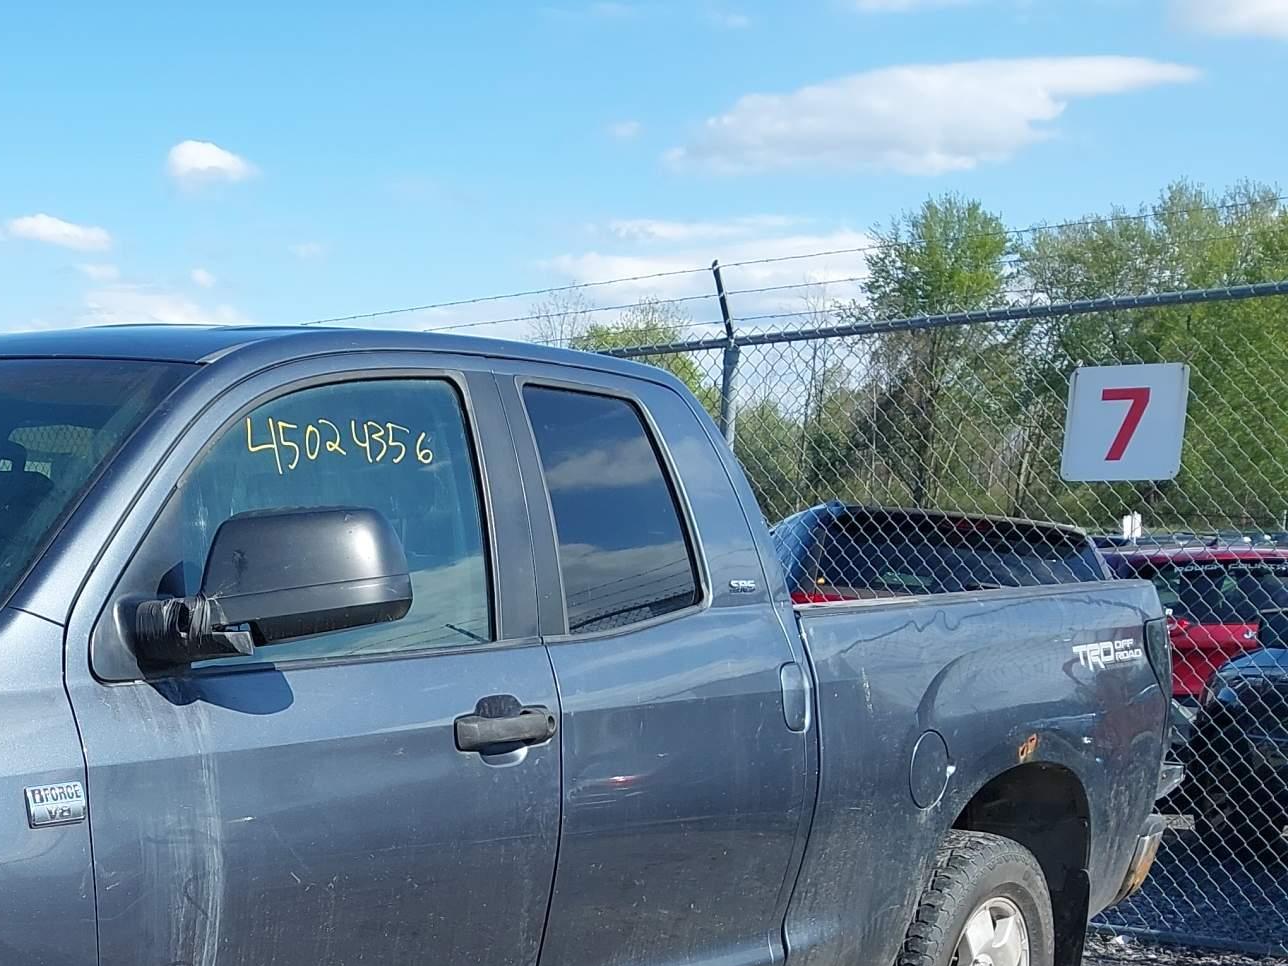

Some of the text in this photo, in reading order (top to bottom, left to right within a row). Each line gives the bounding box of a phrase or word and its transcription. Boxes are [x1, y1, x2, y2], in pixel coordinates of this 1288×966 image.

[1101, 387, 1150, 461] 7
[246, 417, 433, 475] 45024356
[1072, 638, 1134, 673] TRD OFF
[1115, 648, 1142, 661] ROAD
[45, 806, 72, 821] V8
